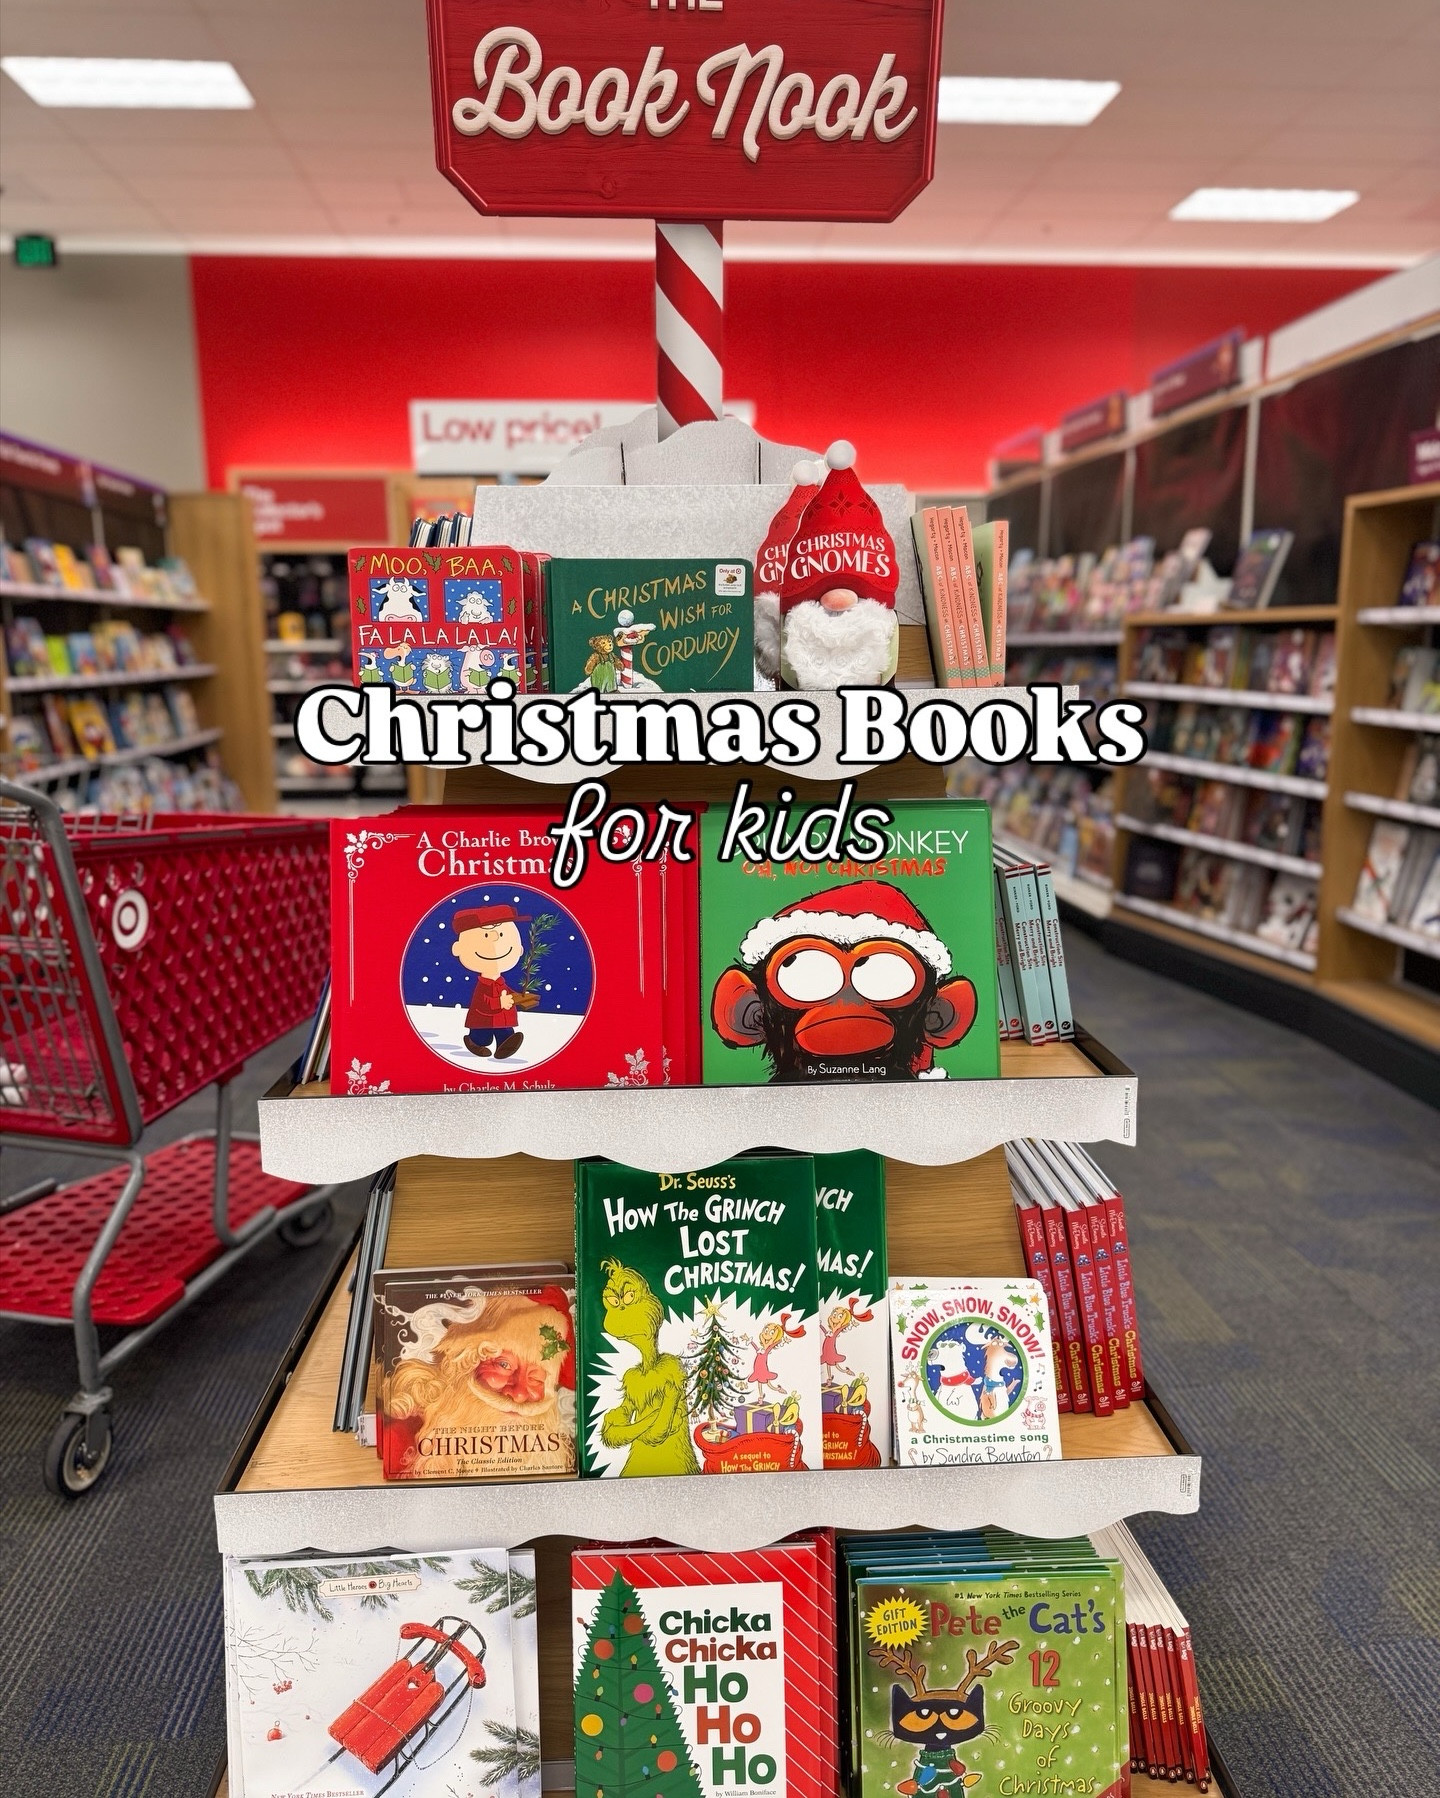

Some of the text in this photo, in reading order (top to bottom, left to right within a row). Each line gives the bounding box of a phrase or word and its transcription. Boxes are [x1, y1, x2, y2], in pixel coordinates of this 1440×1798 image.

[452, 26, 918, 163] Book Nook
[421, 411, 493, 443] Low
[796, 532, 886, 555] CHRISTMAS
[370, 553, 503, 577] MOO, BAA,
[790, 551, 891, 580] GNOMES
[571, 570, 707, 619] A CHRISTMAS
[660, 602, 733, 631] WISH FOR
[359, 625, 518, 645] FA LA LA LA LA!
[641, 627, 740, 683] CORDUROY
[416, 829, 558, 849] A Charlie Bro
[418, 848, 574, 877] Christm
[807, 1063, 886, 1076] By Suzanne Lang
[659, 1172, 736, 1191] Dr. Seuss's
[602, 1194, 786, 1238] HOW The GRINCH
[679, 1225, 750, 1258] LOST
[664, 1260, 806, 1295] CHRISTMAS!
[1058, 1269, 1069, 1291] Little
[1099, 1265, 1111, 1288] Little
[1116, 1258, 1128, 1280] Little
[503, 1288, 542, 1296] BESTSELLER
[1081, 1271, 1093, 1294] Little
[1119, 1280, 1131, 1299] Blue
[1062, 1291, 1073, 1309] Blue
[1084, 1294, 1096, 1312] Blue
[1102, 1288, 1114, 1306] Blue
[901, 1297, 1046, 1361] SNOW, SNOW, SNOW!
[1069, 1341, 1083, 1391] Christmas
[1108, 1337, 1121, 1387] Christmas
[1125, 1330, 1137, 1379] Christmas
[1091, 1344, 1105, 1394] Christmas
[433, 1423, 545, 1435] THE NIGHT BEFORE
[831, 1431, 840, 1439] to
[923, 1434, 1015, 1444] Christmastime
[1020, 1434, 1049, 1445] song
[417, 1432, 561, 1457] CHRISTMAS
[922, 1451, 935, 1465] by
[936, 1447, 984, 1465] Sandra
[456, 1456, 523, 1466] The Classic Edition
[481, 1465, 510, 1473] Illustrated
[511, 1465, 518, 1473] by
[542, 1463, 564, 1471] Santore
[721, 1461, 739, 1473] HOW
[753, 1460, 781, 1471] GRINCH
[733, 1451, 772, 1464] A sequel to
[329, 1578, 413, 1592] Little Heroes Big Hearts
[1024, 1590, 1060, 1599] Bestselling
[659, 1607, 771, 1635] Chicka
[883, 1608, 906, 1622] GIFT
[930, 1599, 1106, 1637] Pete the Cat's
[876, 1619, 917, 1636] EDITION
[665, 1635, 777, 1663] Chicka
[1028, 1650, 1060, 1686] 12
[683, 1664, 748, 1704] Ho
[1008, 1692, 1082, 1716] Groovy
[696, 1705, 761, 1745] Ho
[1022, 1719, 1071, 1742] Days
[712, 1746, 777, 1786] Ho
[1036, 1744, 1060, 1768] of
[326, 1790, 364, 1798] BESTSELLER
[750, 1788, 777, 1796] Boniface
[999, 1771, 1096, 1796] Christmas
